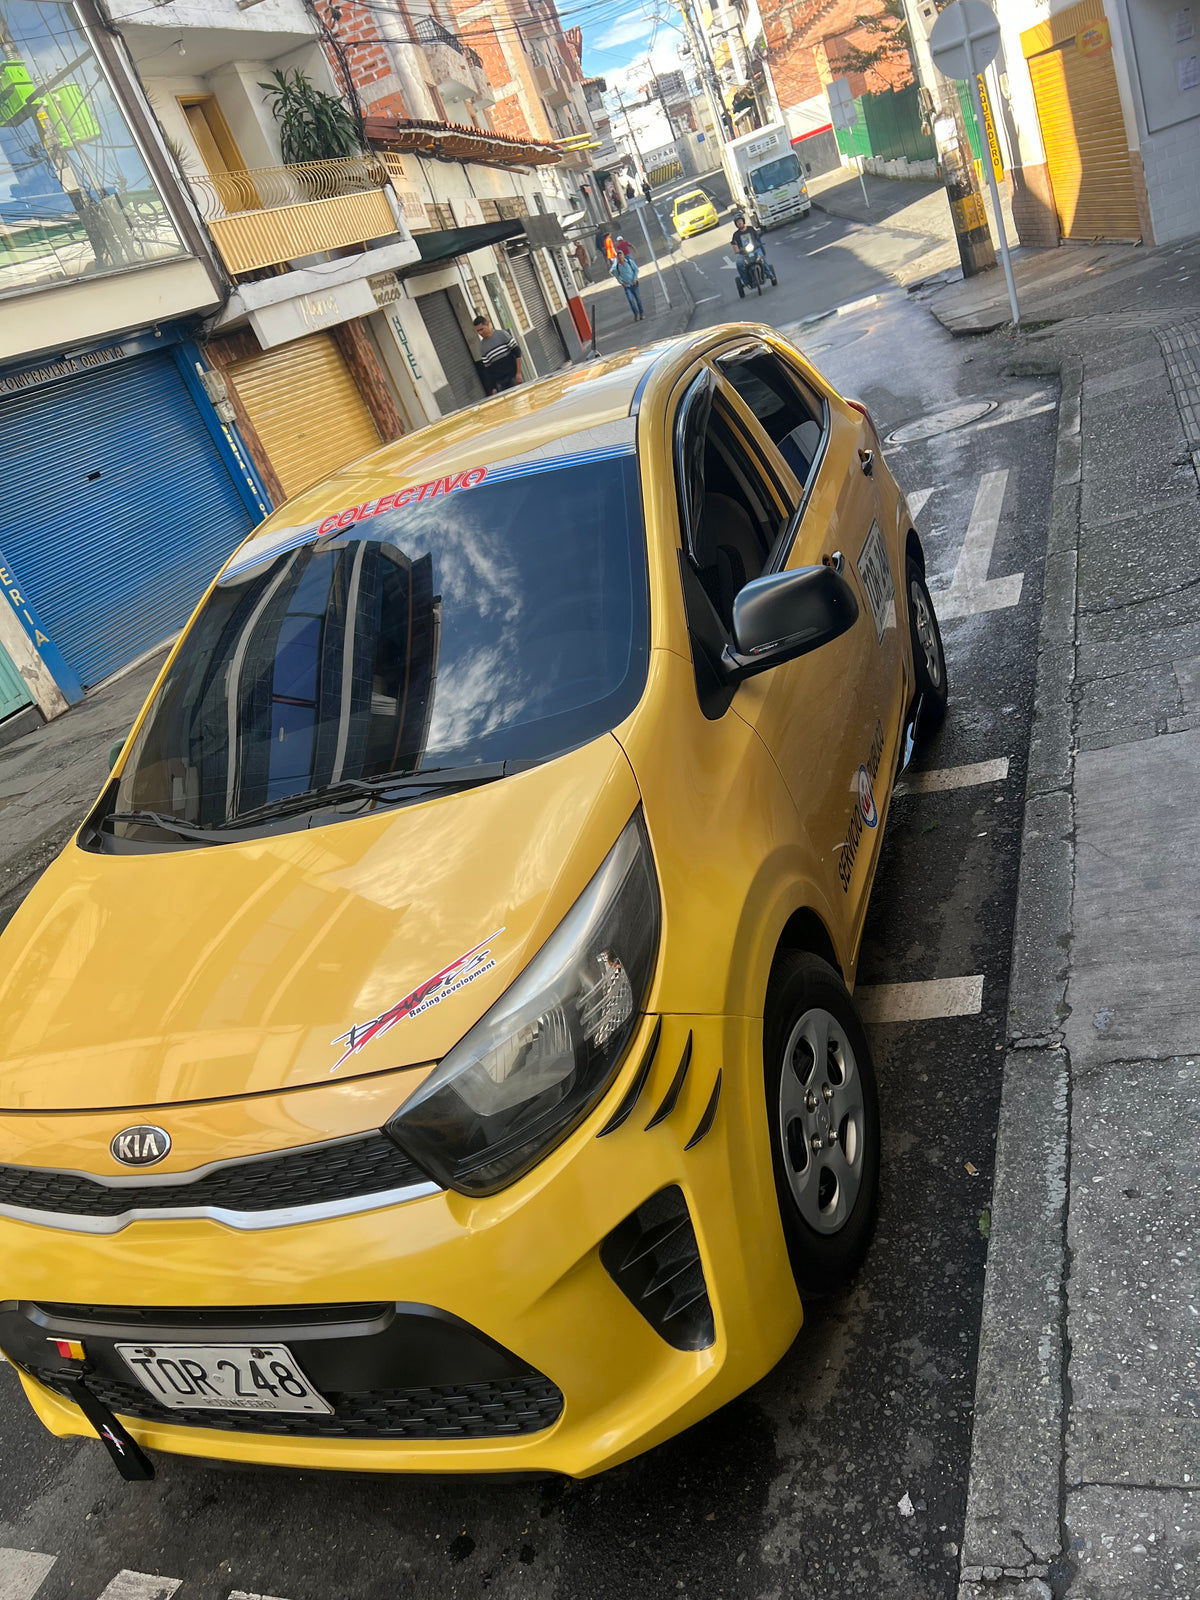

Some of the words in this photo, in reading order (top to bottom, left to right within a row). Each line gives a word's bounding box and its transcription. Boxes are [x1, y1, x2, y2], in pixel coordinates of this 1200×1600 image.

[80, 346, 127, 368] ORIENTAL
[392, 316, 422, 380] HOTEL
[317, 467, 488, 536] COLECTIVO
[838, 804, 863, 894] SERVICIO
[408, 995, 440, 1018] Racing
[440, 959, 496, 999] development
[119, 1134, 160, 1159] KIA
[129, 1357, 222, 1396] TOR
[216, 1359, 308, 1398] 248
